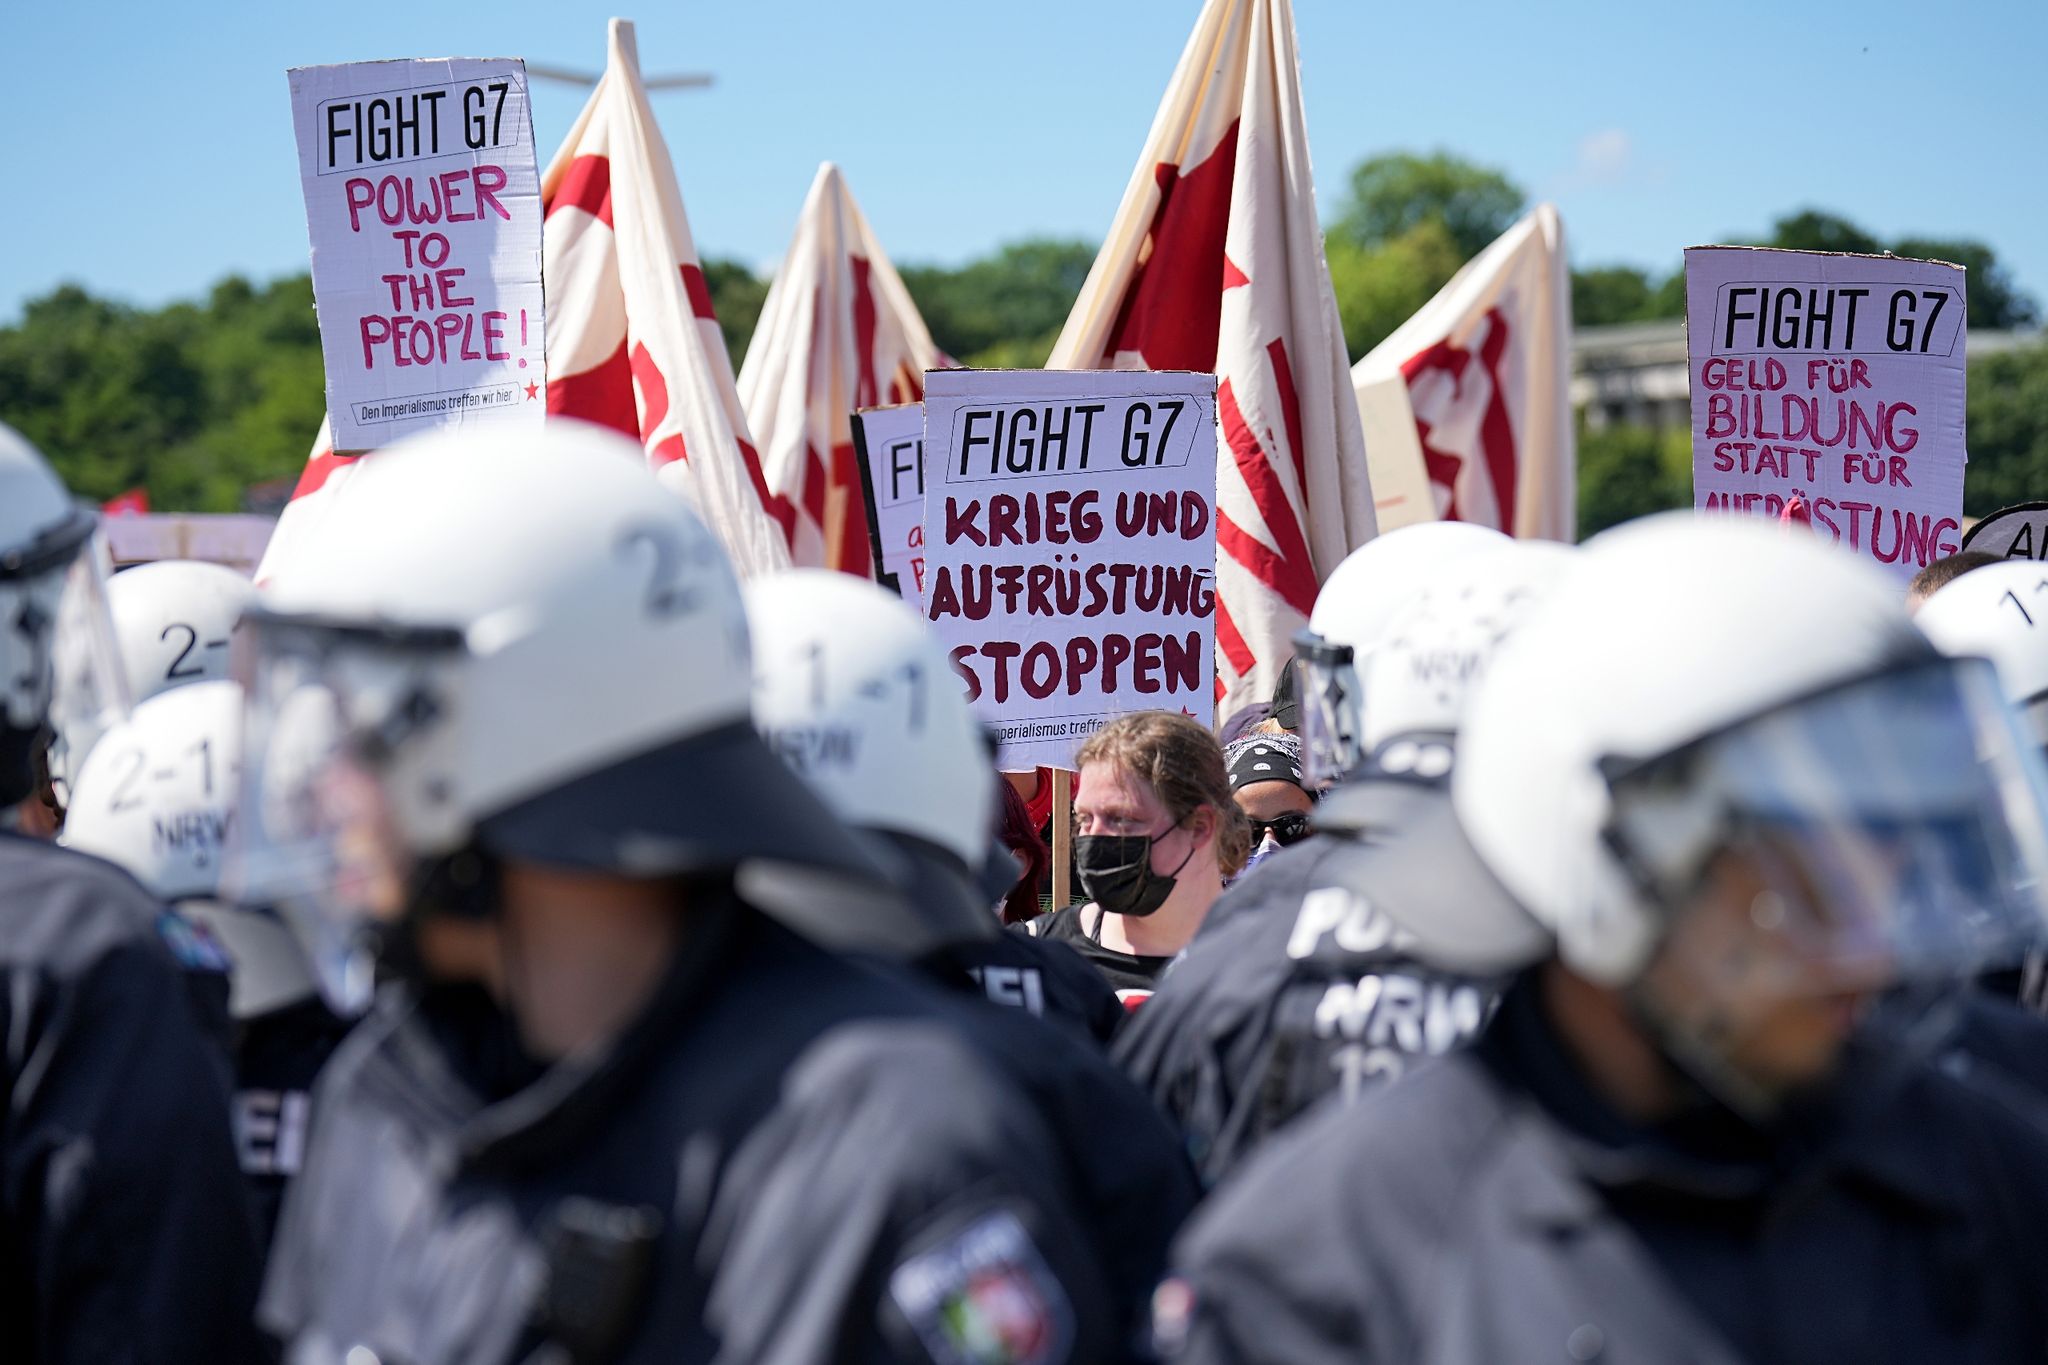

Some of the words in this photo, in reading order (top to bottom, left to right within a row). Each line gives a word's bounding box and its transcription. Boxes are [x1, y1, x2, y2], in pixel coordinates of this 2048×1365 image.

[327, 91, 446, 167] FIGHT
[463, 83, 509, 149] G7
[345, 165, 511, 232] POWER
[392, 231, 450, 269] TO
[382, 268, 475, 312] THE
[1724, 287, 1870, 350] FIGHT
[1886, 289, 1949, 353] G7
[360, 309, 527, 370] PEOPLE!
[361, 406, 380, 420] Den
[382, 398, 447, 420] Imperialismus
[448, 393, 480, 409] treffen
[481, 390, 494, 405] wir
[496, 389, 513, 403] hier
[1701, 357, 1787, 392] GELD
[1807, 359, 1873, 394] FÜR
[959, 404, 1105, 476] FIGHT
[1120, 401, 1185, 467] G7
[1705, 393, 1919, 454] BILDUNG
[1713, 442, 1822, 482] STATT
[1843, 449, 1913, 488] FÜR
[945, 490, 1104, 547] KRIEG
[1115, 490, 1209, 541] UND
[928, 553, 1216, 622] AUFRÜSTUNG
[948, 631, 1202, 704] STOPPEN
[1313, 973, 1482, 1056] NRW
